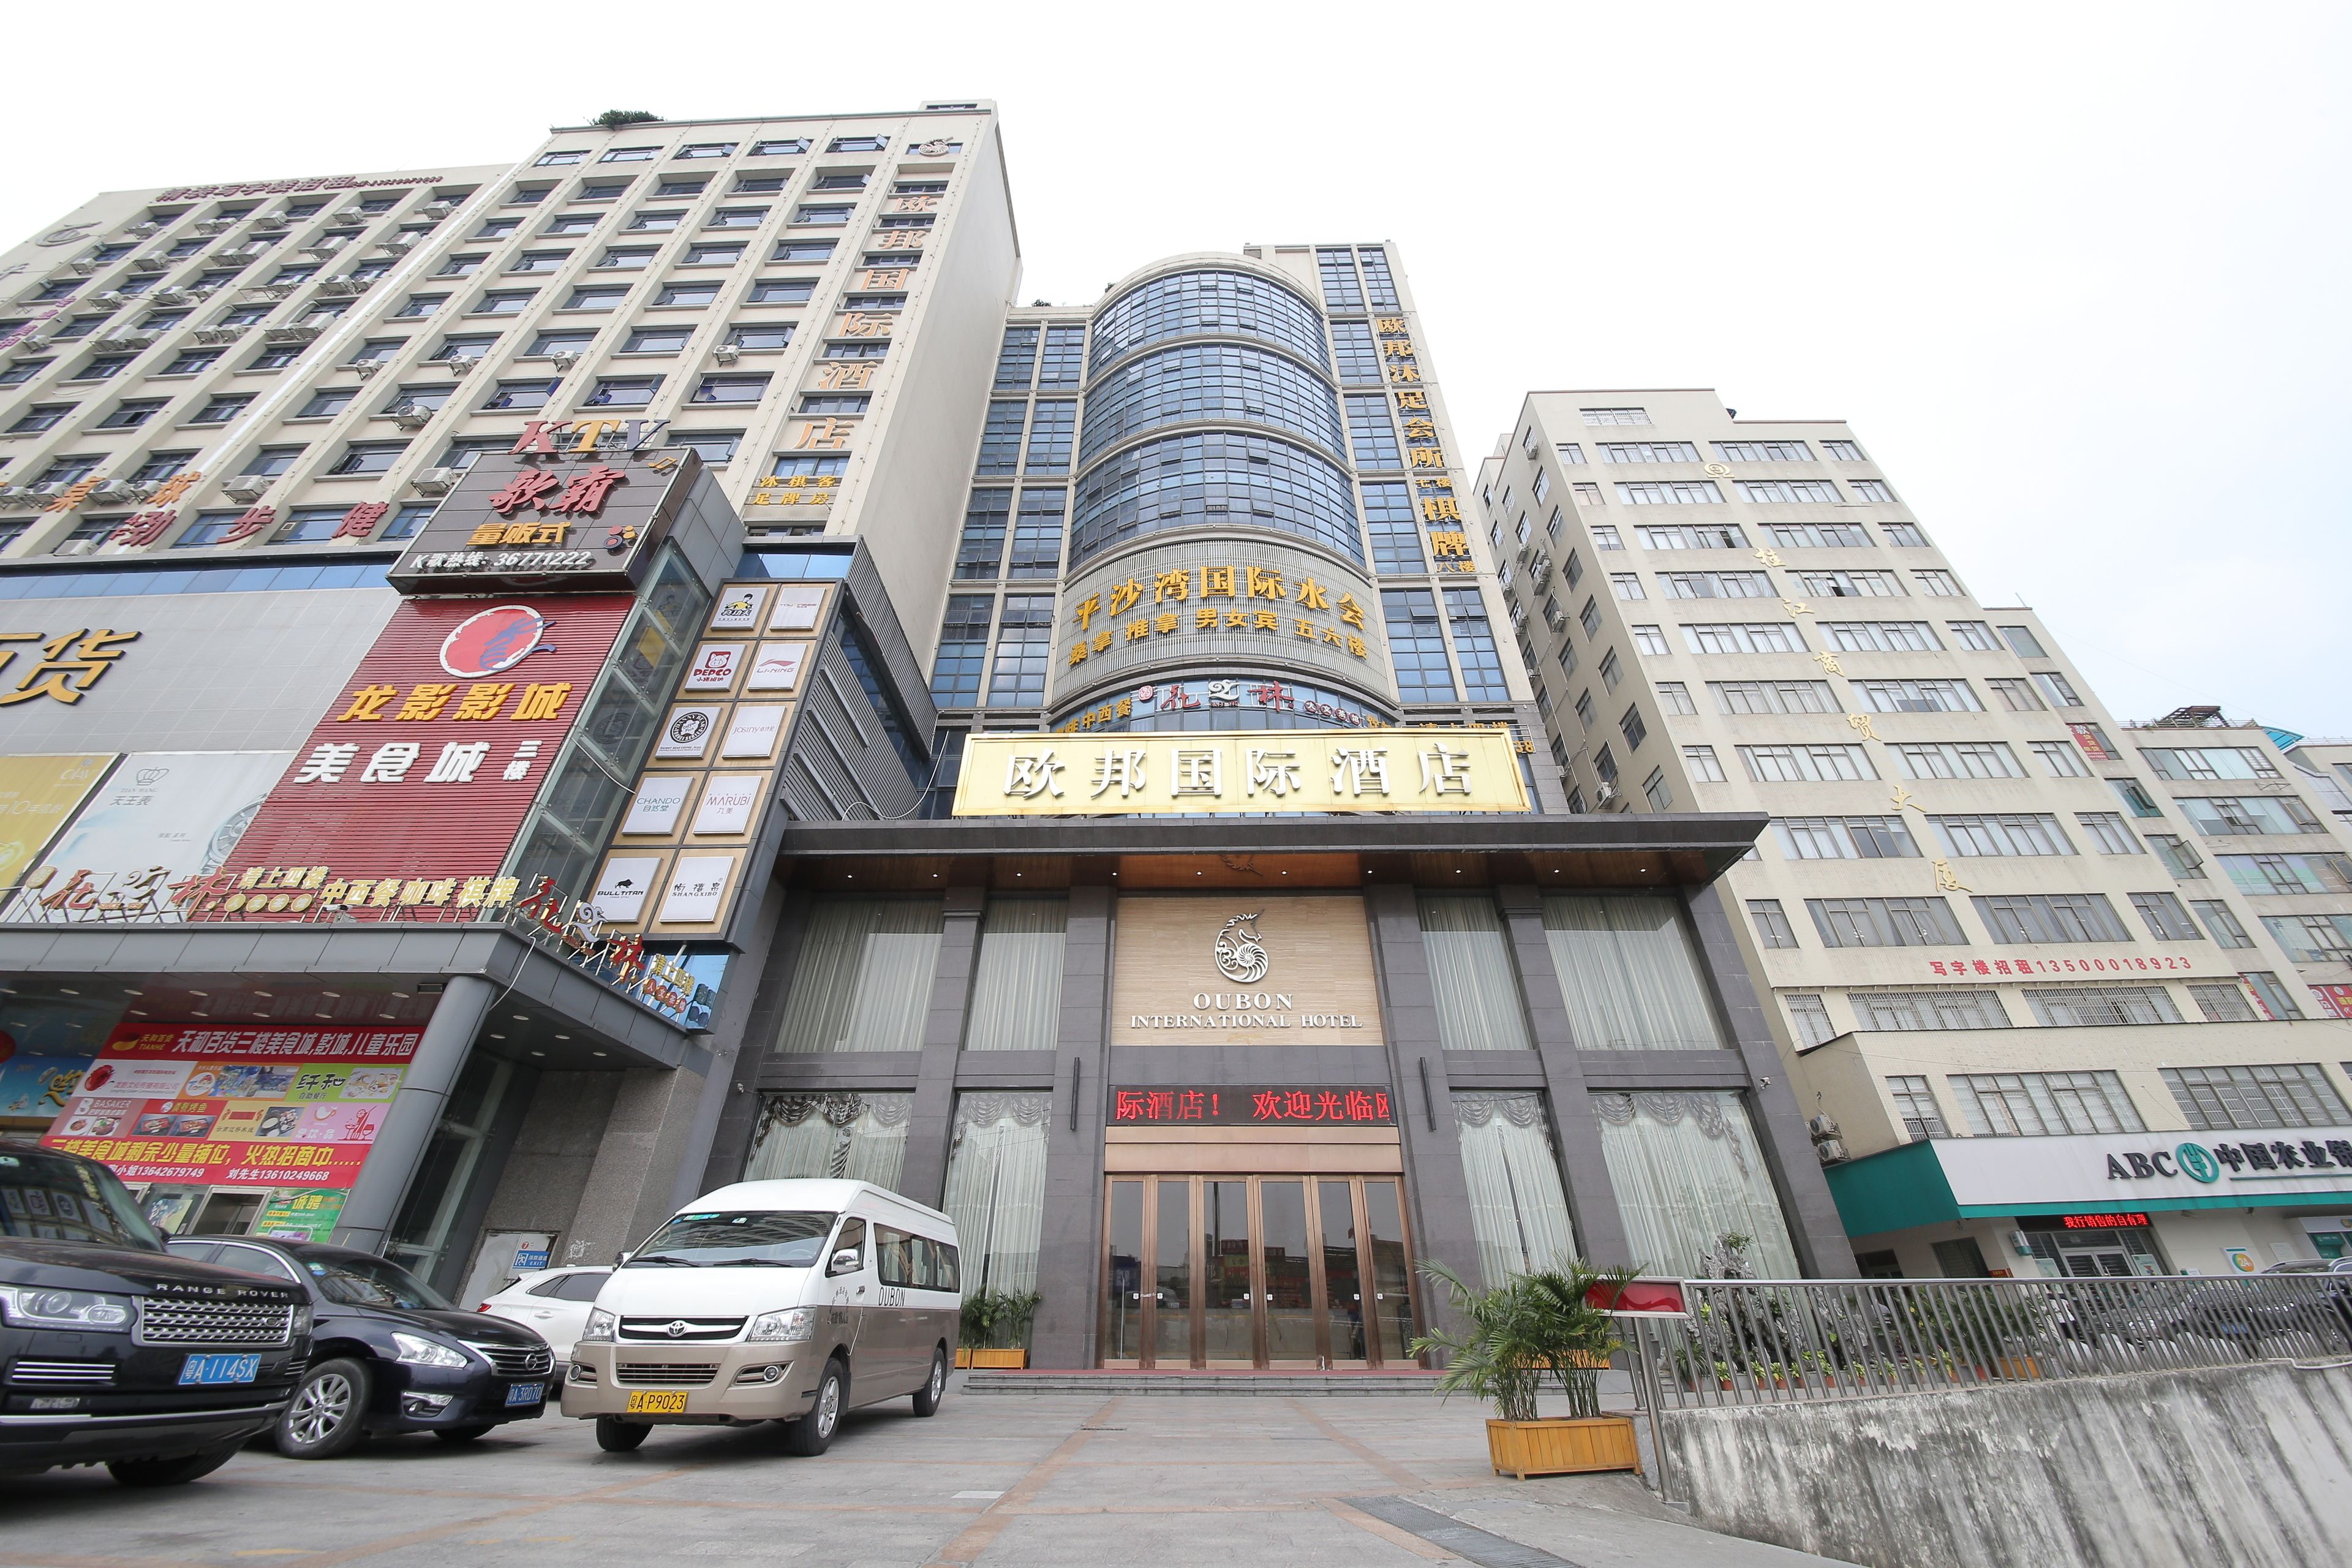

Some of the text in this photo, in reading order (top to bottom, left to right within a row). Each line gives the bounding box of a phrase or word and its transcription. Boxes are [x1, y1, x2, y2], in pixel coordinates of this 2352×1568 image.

[791, 195, 938, 450] 欧邦国际酒店
[1376, 317, 1446, 469] 欧邦沐足会所
[508, 418, 671, 454] KTV
[488, 466, 627, 514] 歌霸
[466, 521, 573, 546] 量贩式
[1422, 497, 1470, 557] 棋牌
[493, 550, 593, 568] 36771222
[1072, 564, 1365, 631] 平沙湾国际水会
[1125, 612, 1180, 641] 推拿
[1194, 607, 1280, 631] 男女宾
[1068, 630, 1114, 666] 桑拿
[1293, 617, 1368, 660] 五六楼
[693, 668, 732, 677] PEPCO
[336, 682, 573, 722] 龙影影城
[292, 741, 493, 784] 美食城
[1002, 742, 1473, 799] 欧邦国际酒店
[108, 795, 154, 807] 天王表
[706, 796, 752, 806] MARUBI
[238, 865, 331, 891] 请上四楼
[1192, 992, 1294, 1011] OUBON
[1130, 1013, 1363, 1029] INTERNATIONAL HOTEL
[93, 1100, 132, 1109] BASAKER
[298, 1091, 328, 1100] 自助餐厅
[2106, 1151, 2178, 1180] ABC
[156, 1283, 289, 1298] RANGE ROVER
[878, 1286, 906, 1306] OUBON
